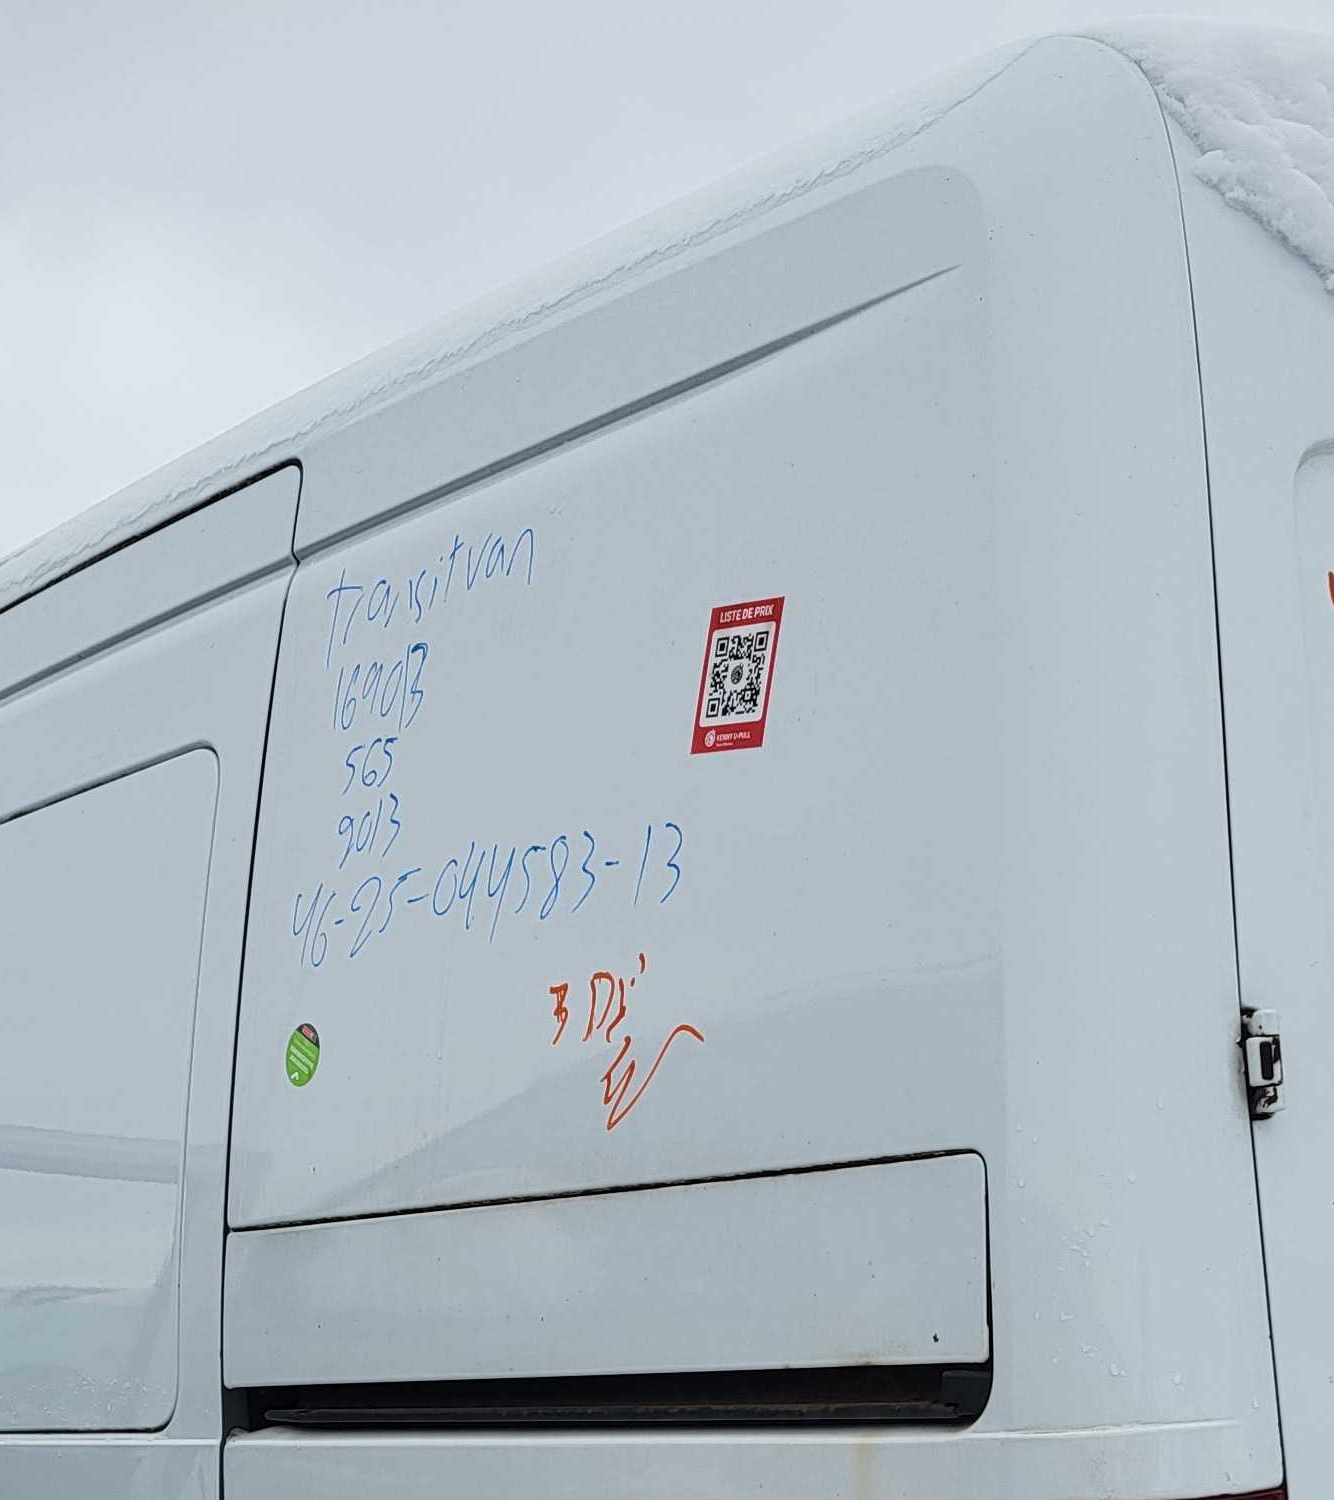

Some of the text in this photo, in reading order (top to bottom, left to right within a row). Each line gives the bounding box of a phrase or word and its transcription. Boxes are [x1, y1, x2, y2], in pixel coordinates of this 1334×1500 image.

[720, 604, 774, 624] LISTE DE PRIX
[342, 737, 398, 795] 565
